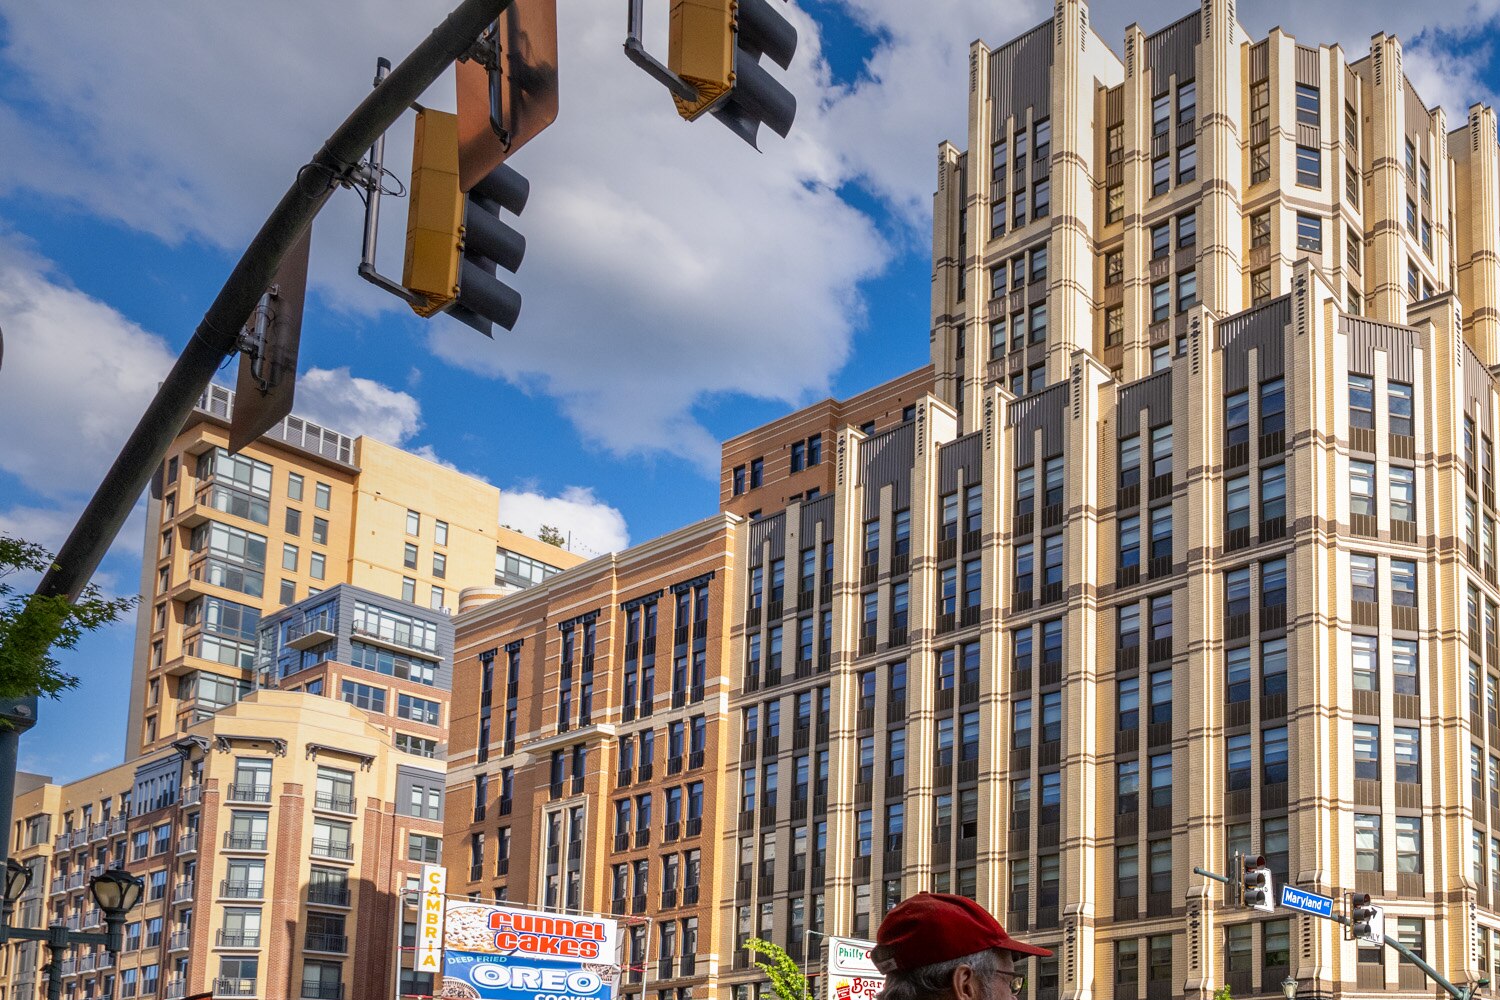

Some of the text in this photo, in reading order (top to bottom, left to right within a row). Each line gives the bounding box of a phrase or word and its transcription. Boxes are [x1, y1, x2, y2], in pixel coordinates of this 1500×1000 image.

[1285, 889, 1322, 911] Maryland
[447, 955, 507, 965] DEEP FRIED
[839, 947, 864, 960] Philly
[470, 963, 602, 996] OREO
